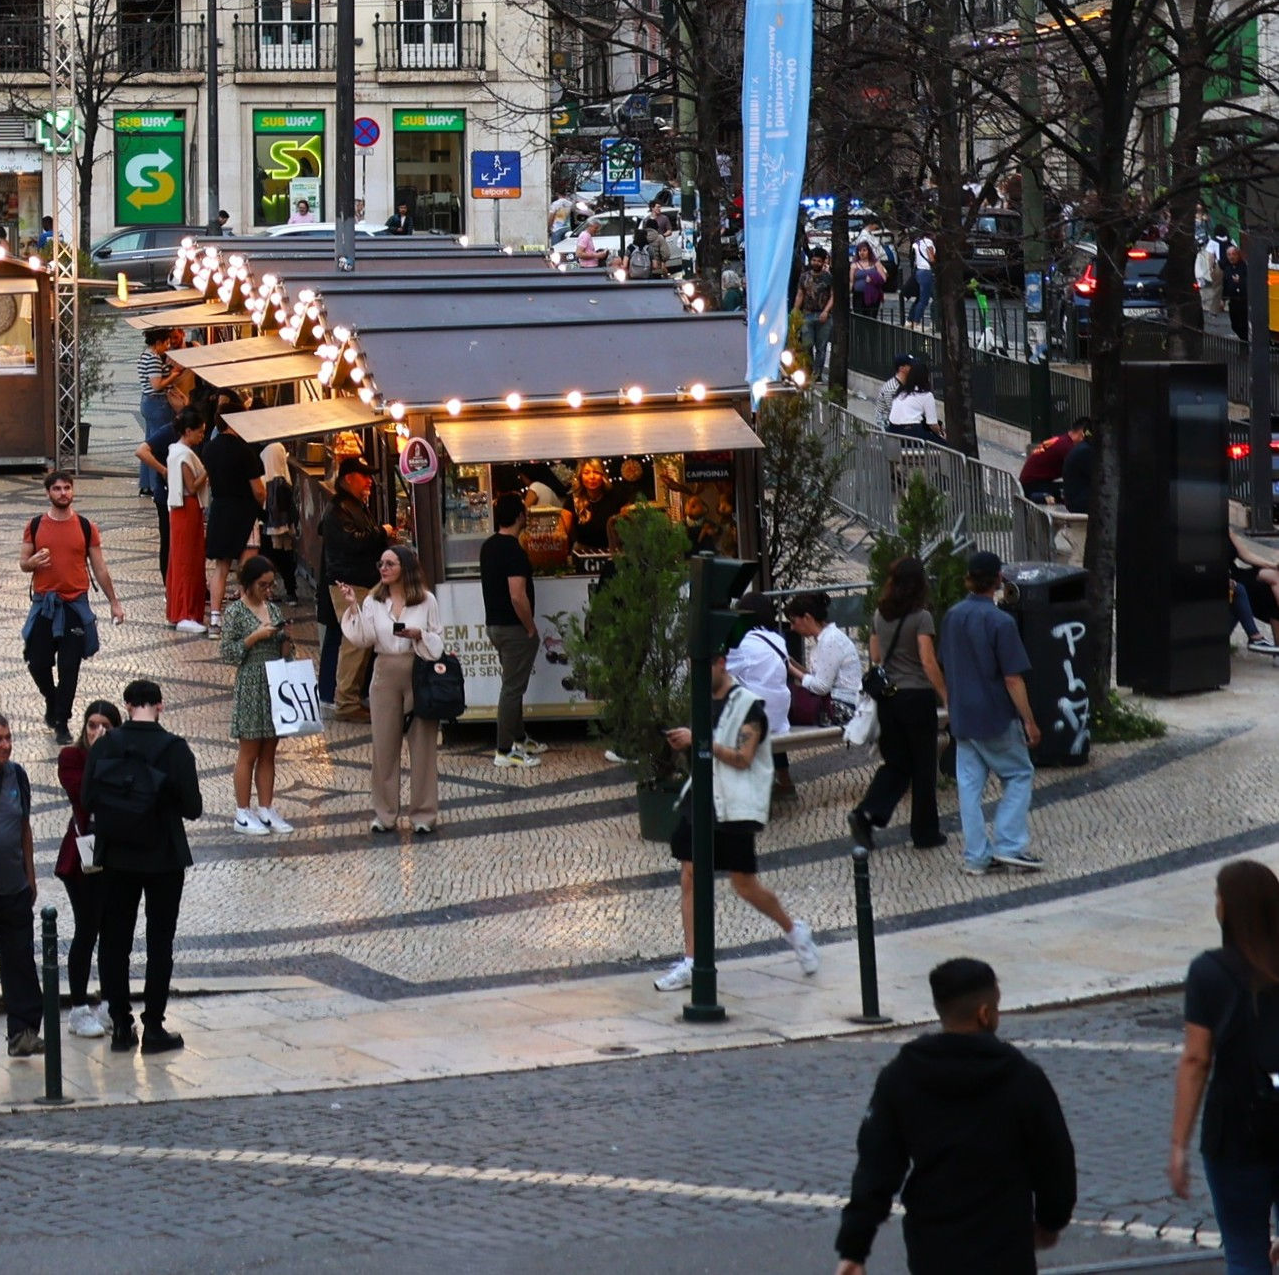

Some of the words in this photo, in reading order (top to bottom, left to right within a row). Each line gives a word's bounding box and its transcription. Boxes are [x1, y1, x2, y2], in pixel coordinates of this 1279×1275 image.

[117, 116, 173, 127] SUBWAY
[261, 116, 317, 127] SUBWAY
[401, 115, 458, 126] SUBWAY
